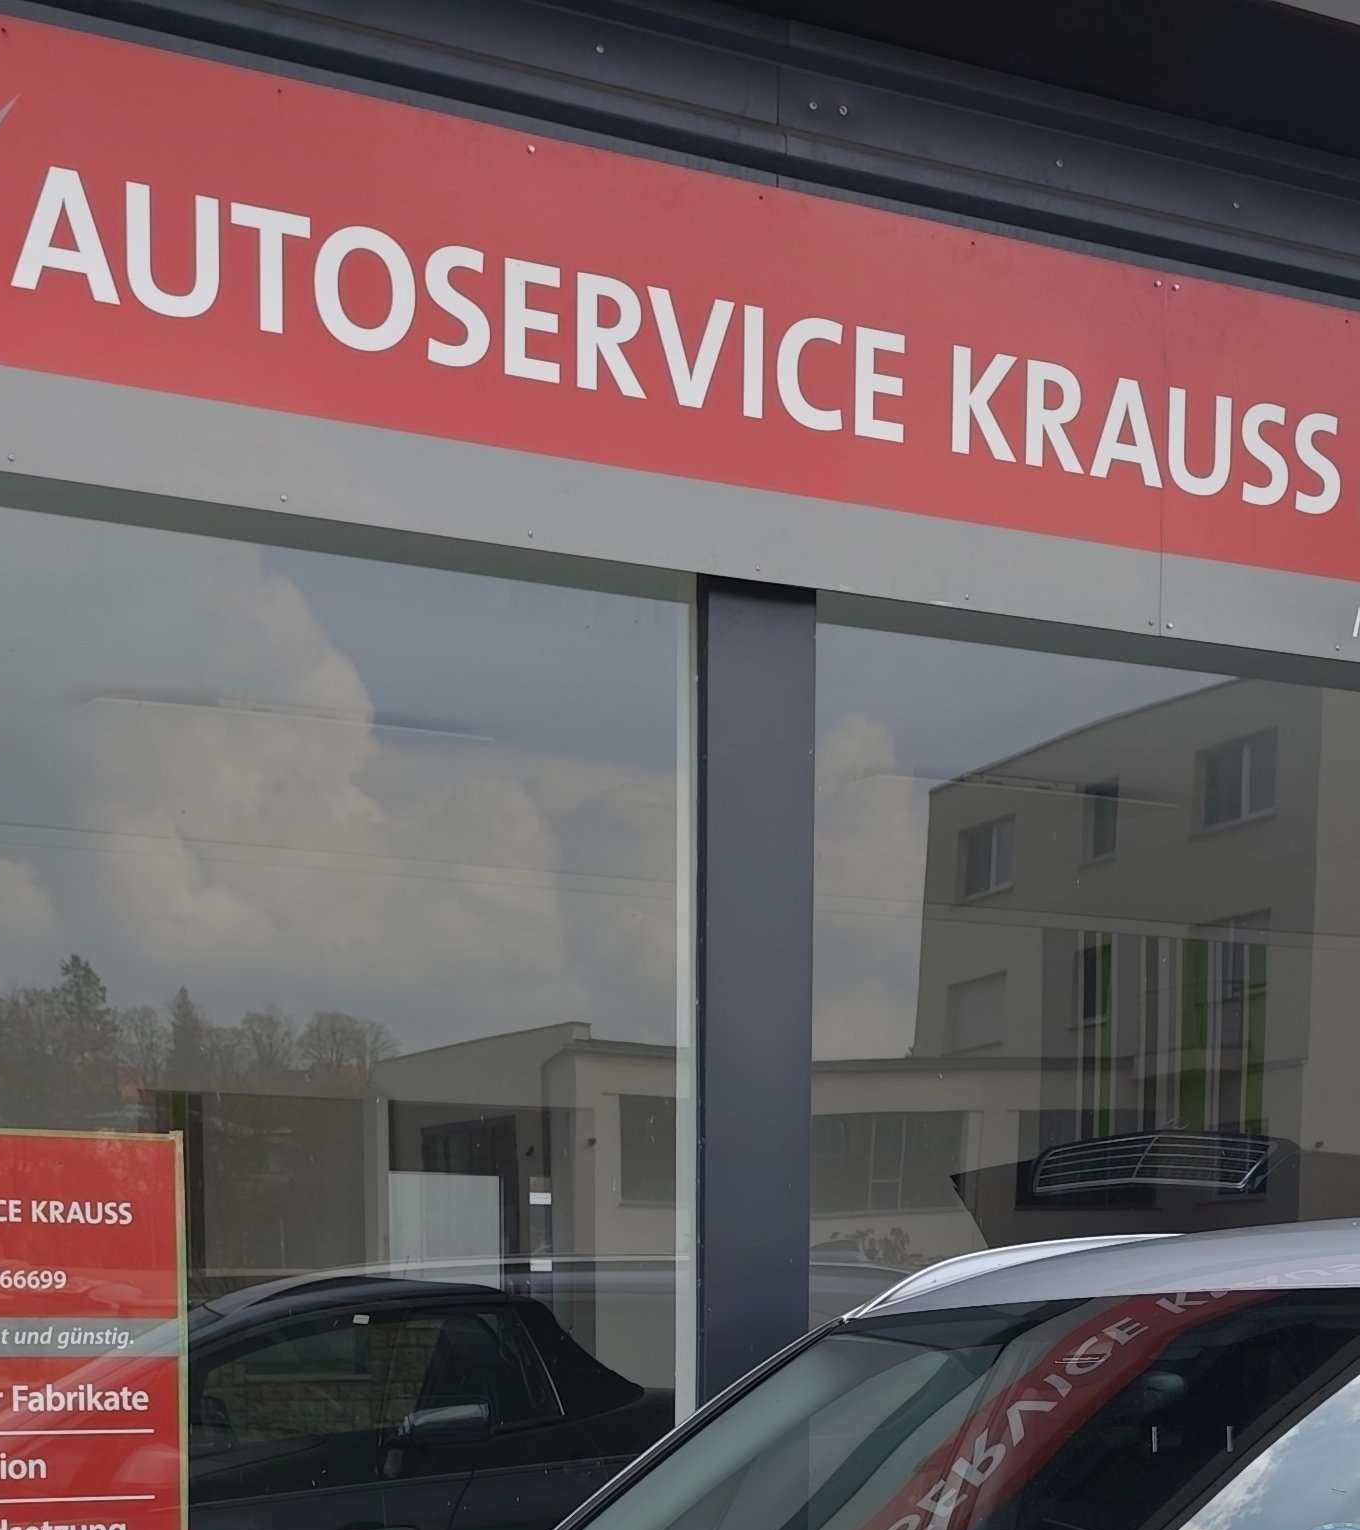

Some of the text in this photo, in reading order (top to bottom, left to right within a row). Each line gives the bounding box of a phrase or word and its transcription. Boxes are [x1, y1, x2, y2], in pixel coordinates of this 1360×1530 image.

[11, 165, 906, 444] AUTOSERVICE
[950, 344, 1341, 514] KRAUSS
[30, 1200, 132, 1225] KRAUSS
[14, 1326, 53, 1346] und
[58, 1328, 136, 1351] günstig.
[11, 1383, 150, 1414] Fabrikate
